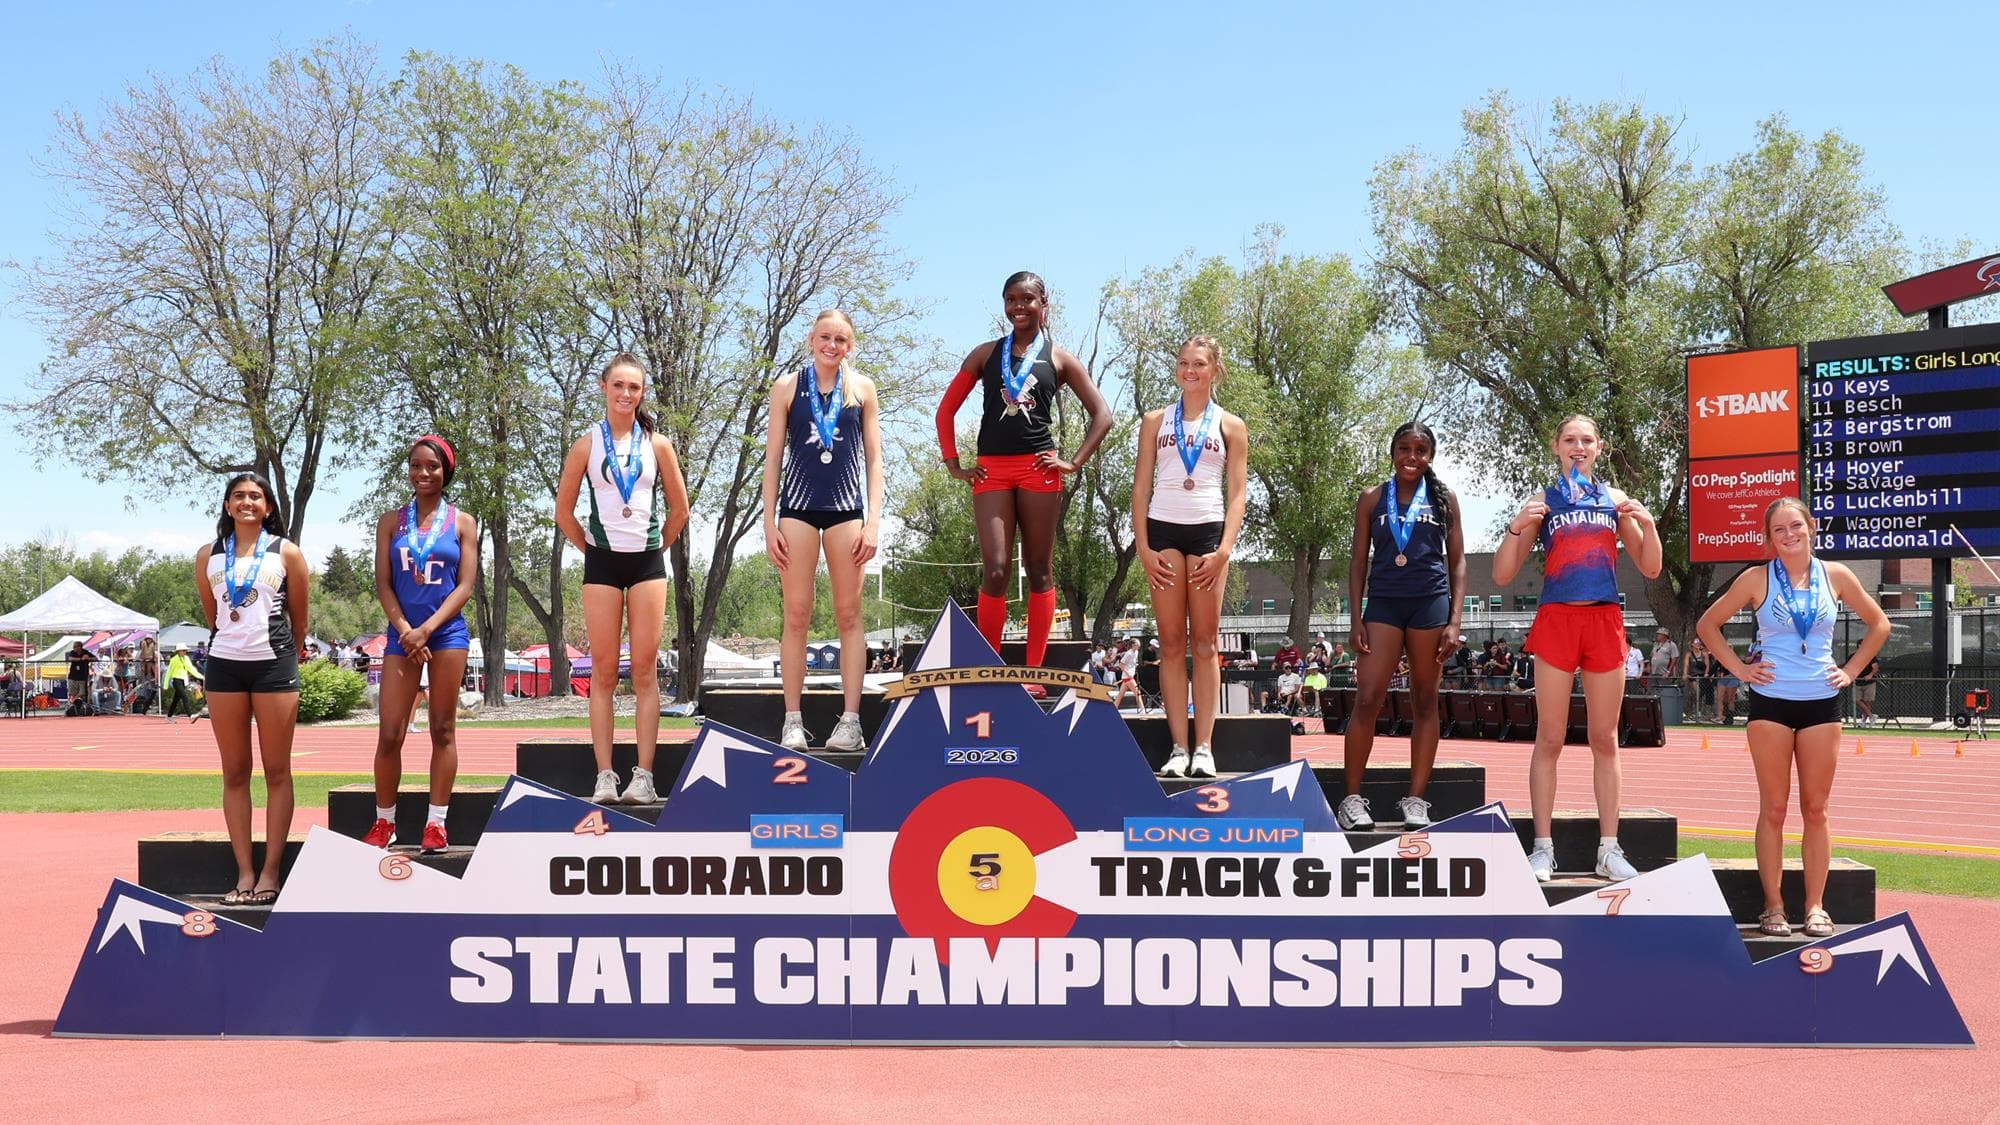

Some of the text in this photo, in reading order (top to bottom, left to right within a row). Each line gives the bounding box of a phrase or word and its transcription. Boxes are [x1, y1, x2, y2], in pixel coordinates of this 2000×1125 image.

[1816, 351, 2000, 378] RESULTS: Girls Long
[1812, 379, 1890, 397] 10 Keys
[1812, 394, 1902, 416] 11 Besch
[1813, 415, 1951, 437] 12 Bergstrom
[1157, 434, 1220, 452] MUSAGS
[1813, 439, 1903, 457] 13 Brown
[1692, 469, 1796, 488] CO Prep Spotlight
[1814, 459, 1904, 477] 14 Hoyer
[1706, 487, 1781, 499] We cover JeffCo Athletics
[1813, 475, 1916, 491] 15 Savage
[1814, 488, 1962, 510] 16 Luckenbill
[1548, 511, 1617, 536] CENTAURUS
[1815, 515, 1927, 532] 17 Wagoner
[1698, 531, 1766, 547] PrepSpotlig
[1814, 529, 1953, 549] 18 Macdonald
[909, 669, 1085, 685] STATE CHAMPION
[965, 711, 992, 738] 1
[947, 750, 1018, 764] 2026
[772, 757, 809, 785] 2
[1195, 786, 1231, 813] 3
[574, 810, 610, 836] 4
[752, 823, 839, 839] GIRLS
[1127, 826, 1299, 845] LONG JUMP
[1397, 832, 1432, 859] 5
[378, 852, 413, 880] 6
[549, 856, 844, 896] COLORADO
[969, 853, 1002, 878] 5
[975, 875, 999, 891] a
[1091, 856, 1487, 898] TRACK & FIELD
[1597, 888, 1631, 915] 7
[181, 911, 216, 938] 8
[1799, 946, 1834, 974] 9
[449, 936, 1563, 1007] STATE CHAMPIONSHIPS
